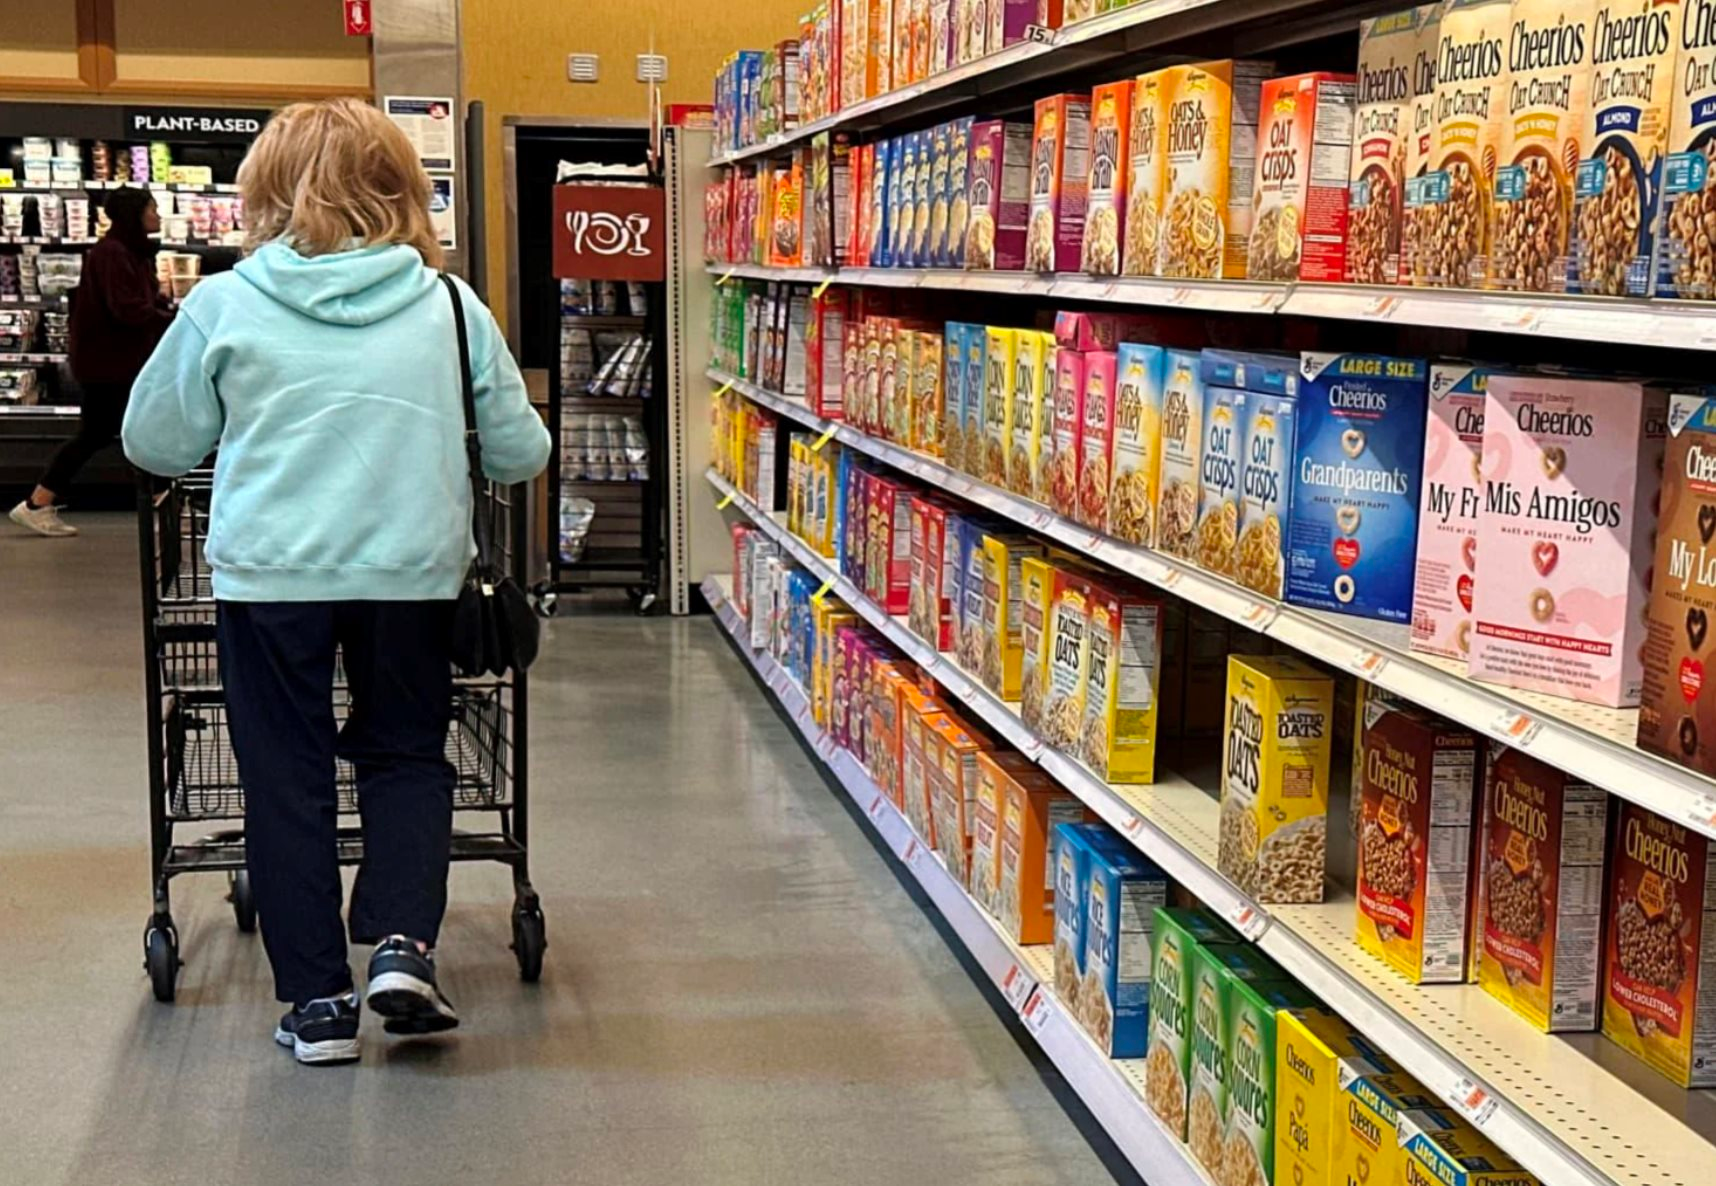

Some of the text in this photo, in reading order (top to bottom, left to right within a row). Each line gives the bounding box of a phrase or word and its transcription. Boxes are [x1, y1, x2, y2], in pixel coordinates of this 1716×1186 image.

[1509, 13, 1585, 72] Cheerios
[1592, 1, 1671, 65] Cheerios
[1438, 29, 1503, 84] Cheerios
[1357, 56, 1409, 104] Cheerios
[134, 115, 260, 133] PLANT-BASED
[1170, 99, 1206, 122] OATS &
[1602, 111, 1631, 126] ALMOND
[1168, 121, 1207, 160] Honey
[1270, 119, 1293, 148] OAT
[1340, 359, 1415, 377] LARGE SIZE
[1329, 385, 1387, 410] Cheerios
[1517, 403, 1593, 437] Cheerios
[1210, 425, 1231, 455] OAT
[1252, 434, 1274, 466] OAT
[1301, 456, 1409, 496] Grandparents
[1427, 482, 1456, 523] My
[1484, 480, 1622, 534] Mis Amigos
[1501, 526, 1594, 544] MAKE MY HEART HAPPY
[1669, 539, 1696, 591] My
[1055, 634, 1081, 670] OATS
[1561, 638, 1583, 650] HAPPY
[1582, 642, 1610, 654] HEARTS
[1277, 712, 1325, 723] TOASTED
[1278, 723, 1324, 739] OATS
[1227, 730, 1260, 794] OATS
[1368, 749, 1418, 804] Cheerios
[1494, 781, 1548, 841] Cheerios
[1625, 817, 1689, 884] Cheerios
[1375, 901, 1411, 926] CHOLESTEROL
[1501, 944, 1540, 971] CHOLESTEROL
[1612, 978, 1678, 1022] LOWER CHOLESTEROL
[1286, 1043, 1315, 1086] Cheerios
[1357, 1079, 1398, 1126] LARGE SIZE
[1348, 1099, 1382, 1146] Cheerios
[1415, 1138, 1456, 1186] LARGE SIZE
